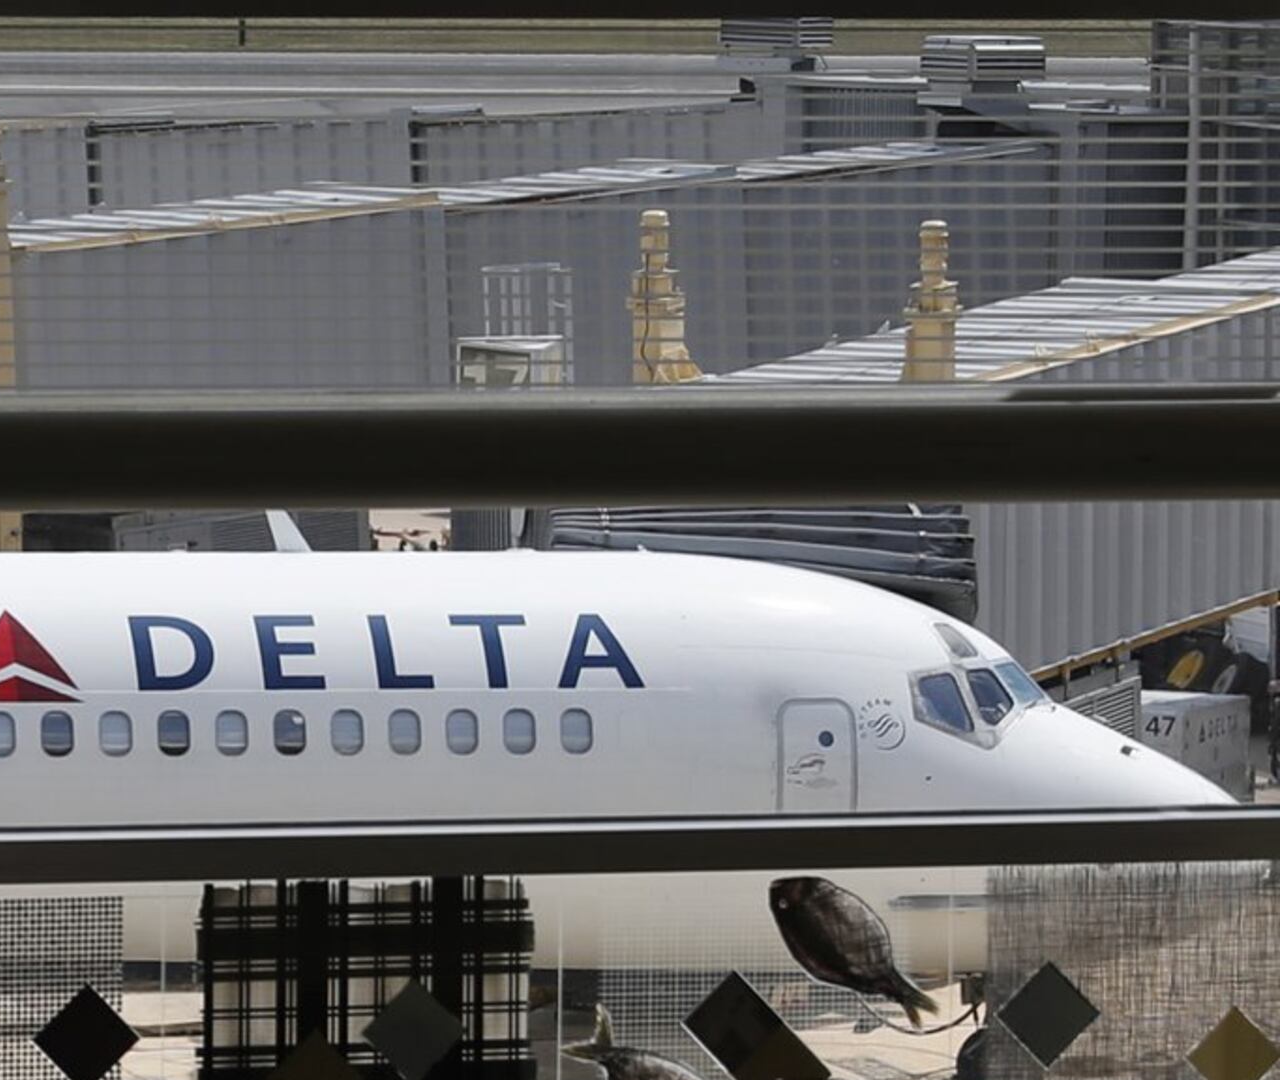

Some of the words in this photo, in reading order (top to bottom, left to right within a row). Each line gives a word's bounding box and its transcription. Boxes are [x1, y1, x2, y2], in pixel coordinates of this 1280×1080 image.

[463, 353, 529, 391] 17
[127, 614, 646, 691] DELTA
[1145, 715, 1176, 737] 47
